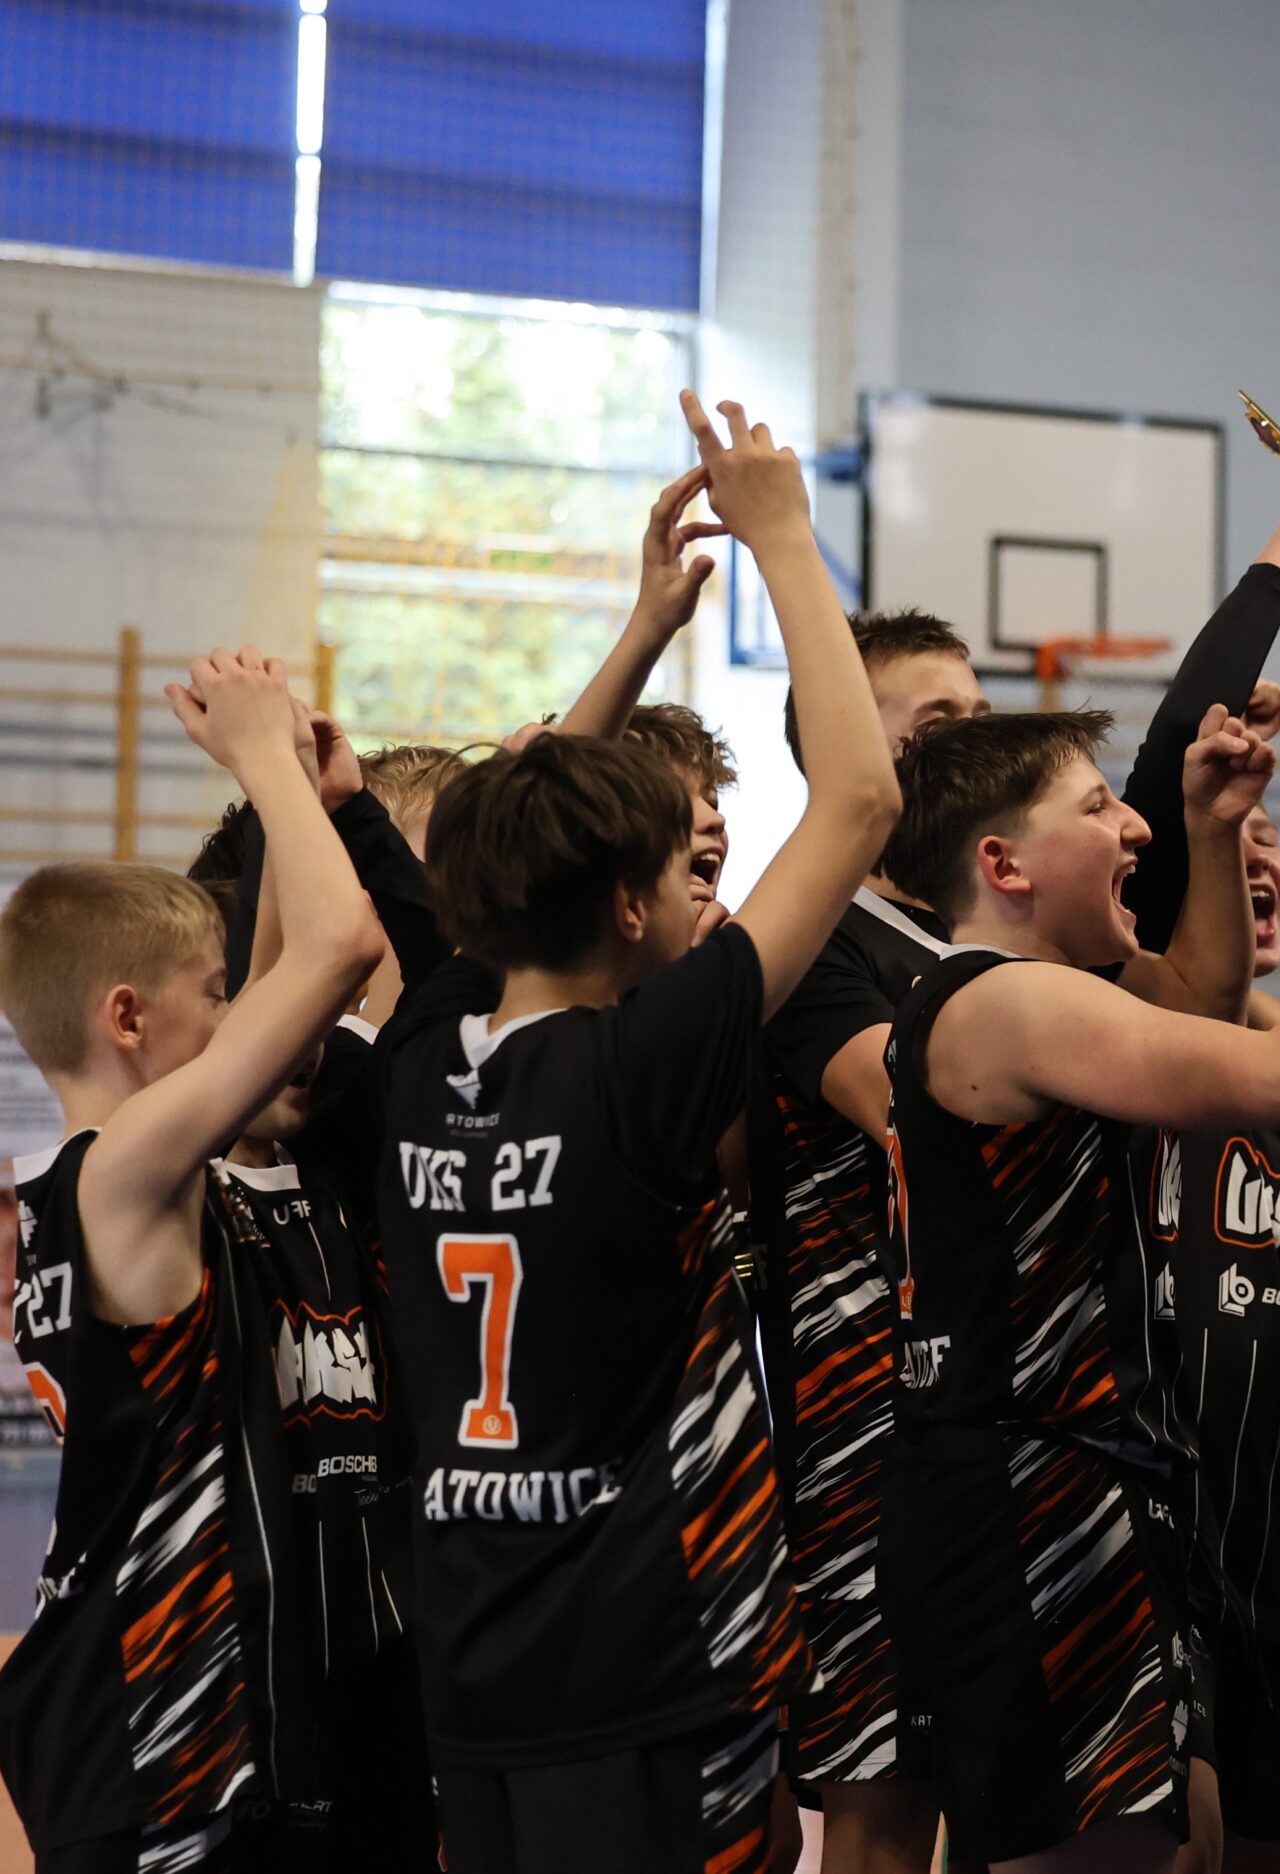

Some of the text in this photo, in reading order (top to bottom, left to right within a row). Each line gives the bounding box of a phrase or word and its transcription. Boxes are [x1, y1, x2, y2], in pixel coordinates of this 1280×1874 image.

[399, 1135, 563, 1213] UKS 27
[26, 1261, 74, 1339] 27
[437, 1232, 524, 1449] 7
